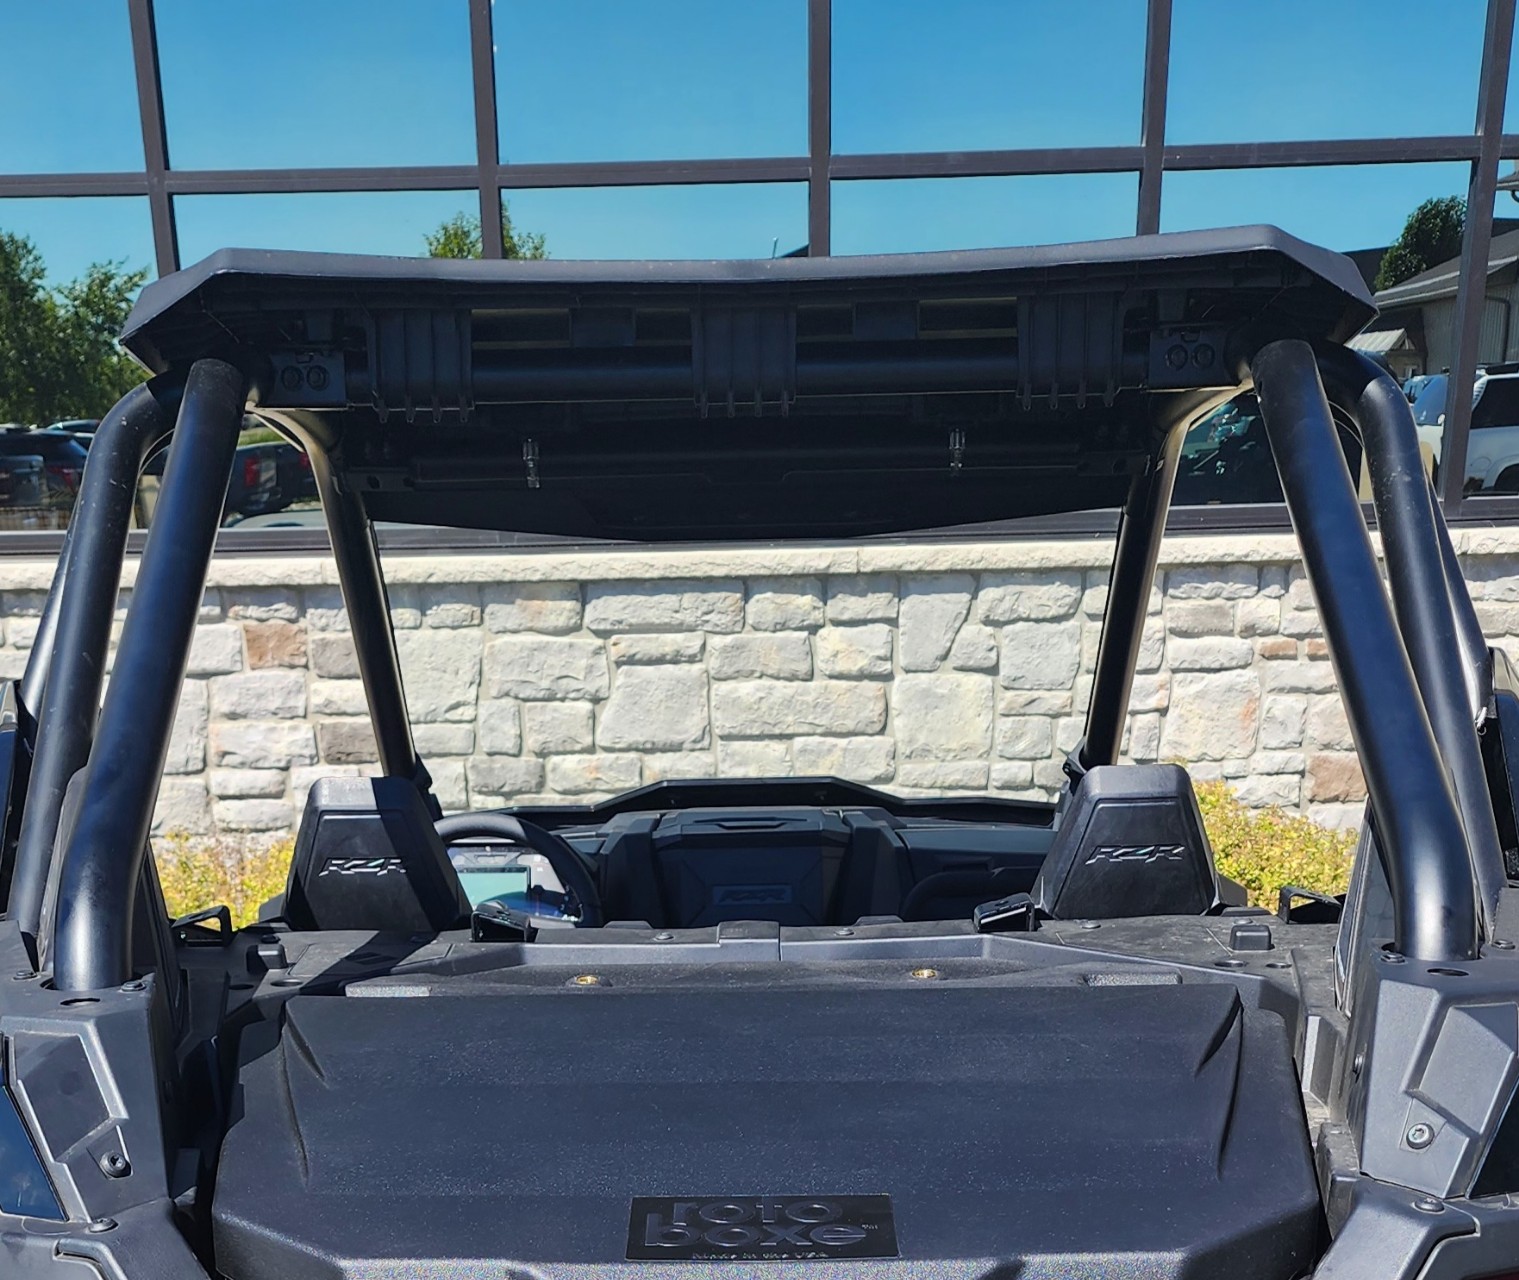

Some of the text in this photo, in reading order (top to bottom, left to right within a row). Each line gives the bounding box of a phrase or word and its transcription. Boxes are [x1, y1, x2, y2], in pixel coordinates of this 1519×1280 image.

[1085, 844, 1186, 865] RZR
[319, 857, 407, 876] RZR
[644, 1213, 867, 1247] boxe
